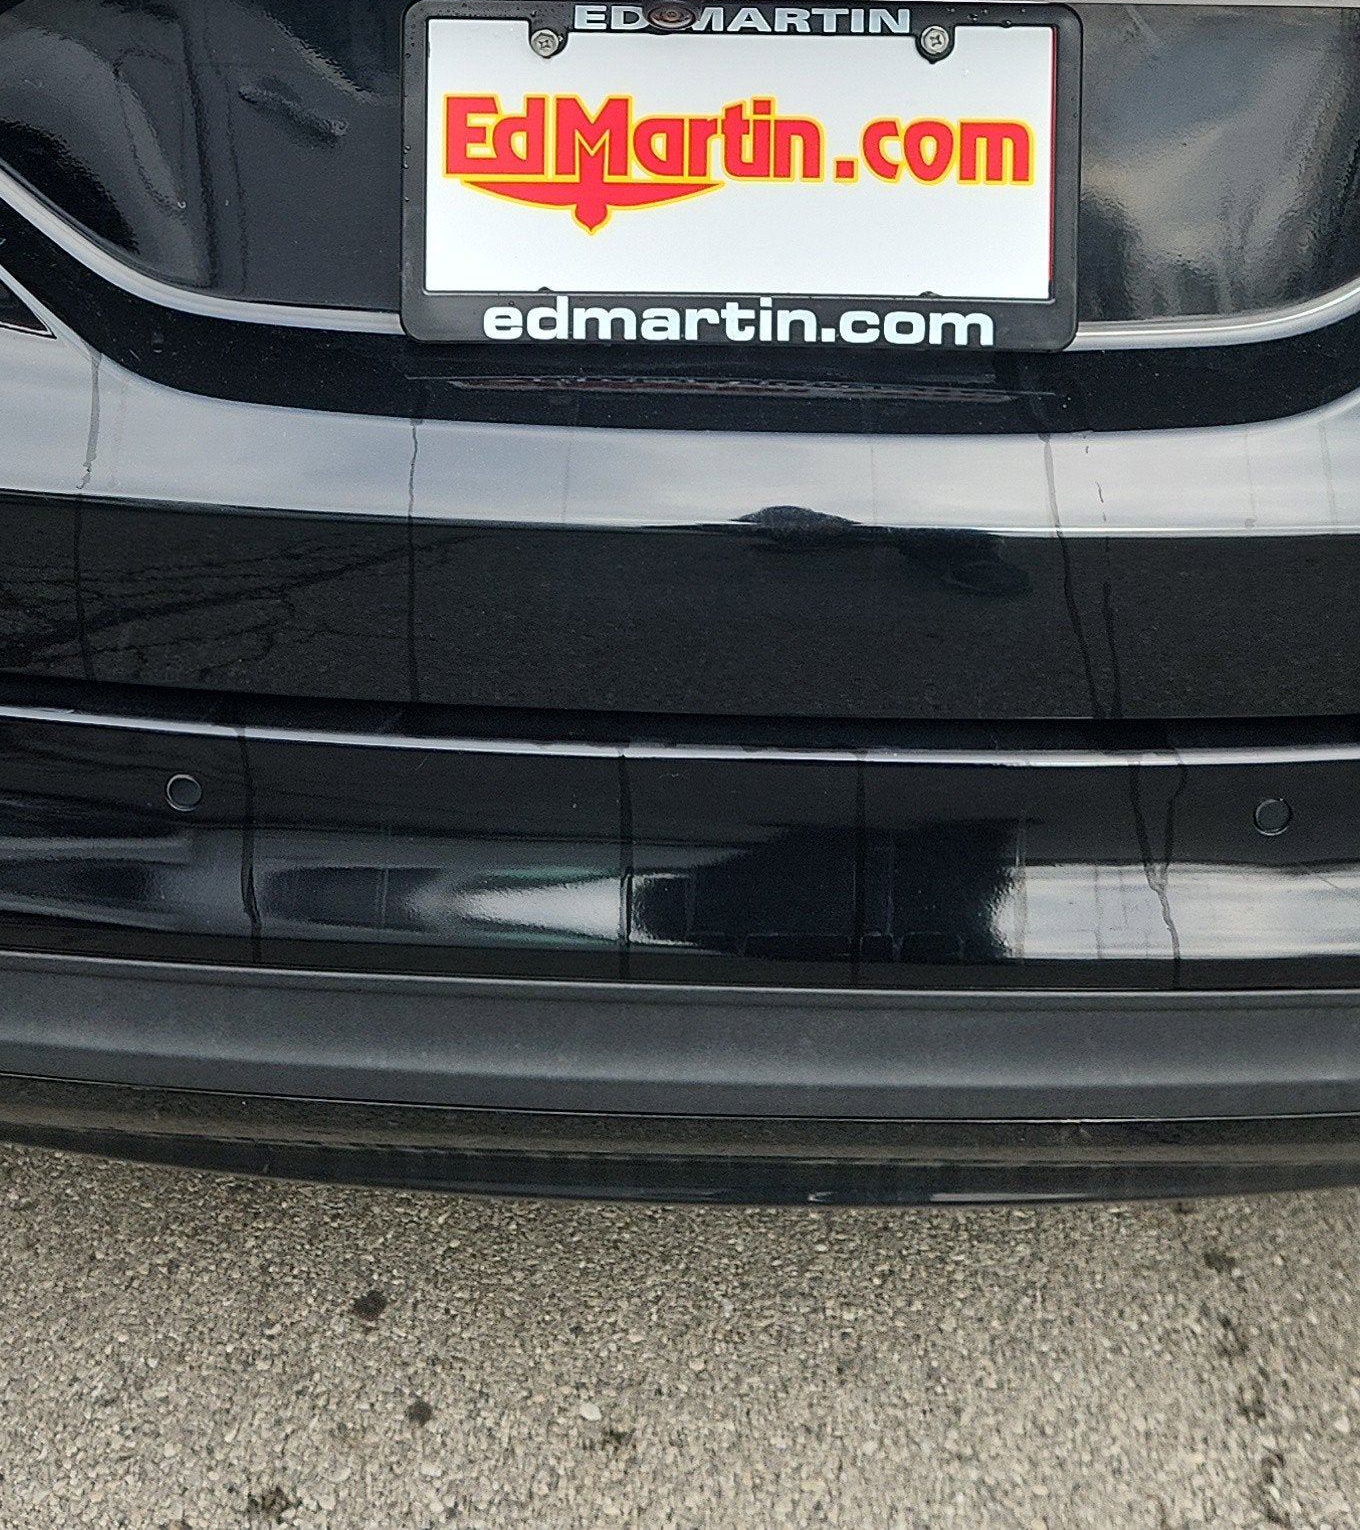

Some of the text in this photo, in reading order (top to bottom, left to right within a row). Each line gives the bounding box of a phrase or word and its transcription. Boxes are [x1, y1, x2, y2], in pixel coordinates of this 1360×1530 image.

[574, 5, 648, 30] ED
[443, 93, 1035, 186] EdMartin.com
[482, 296, 996, 348] edmartin.com
